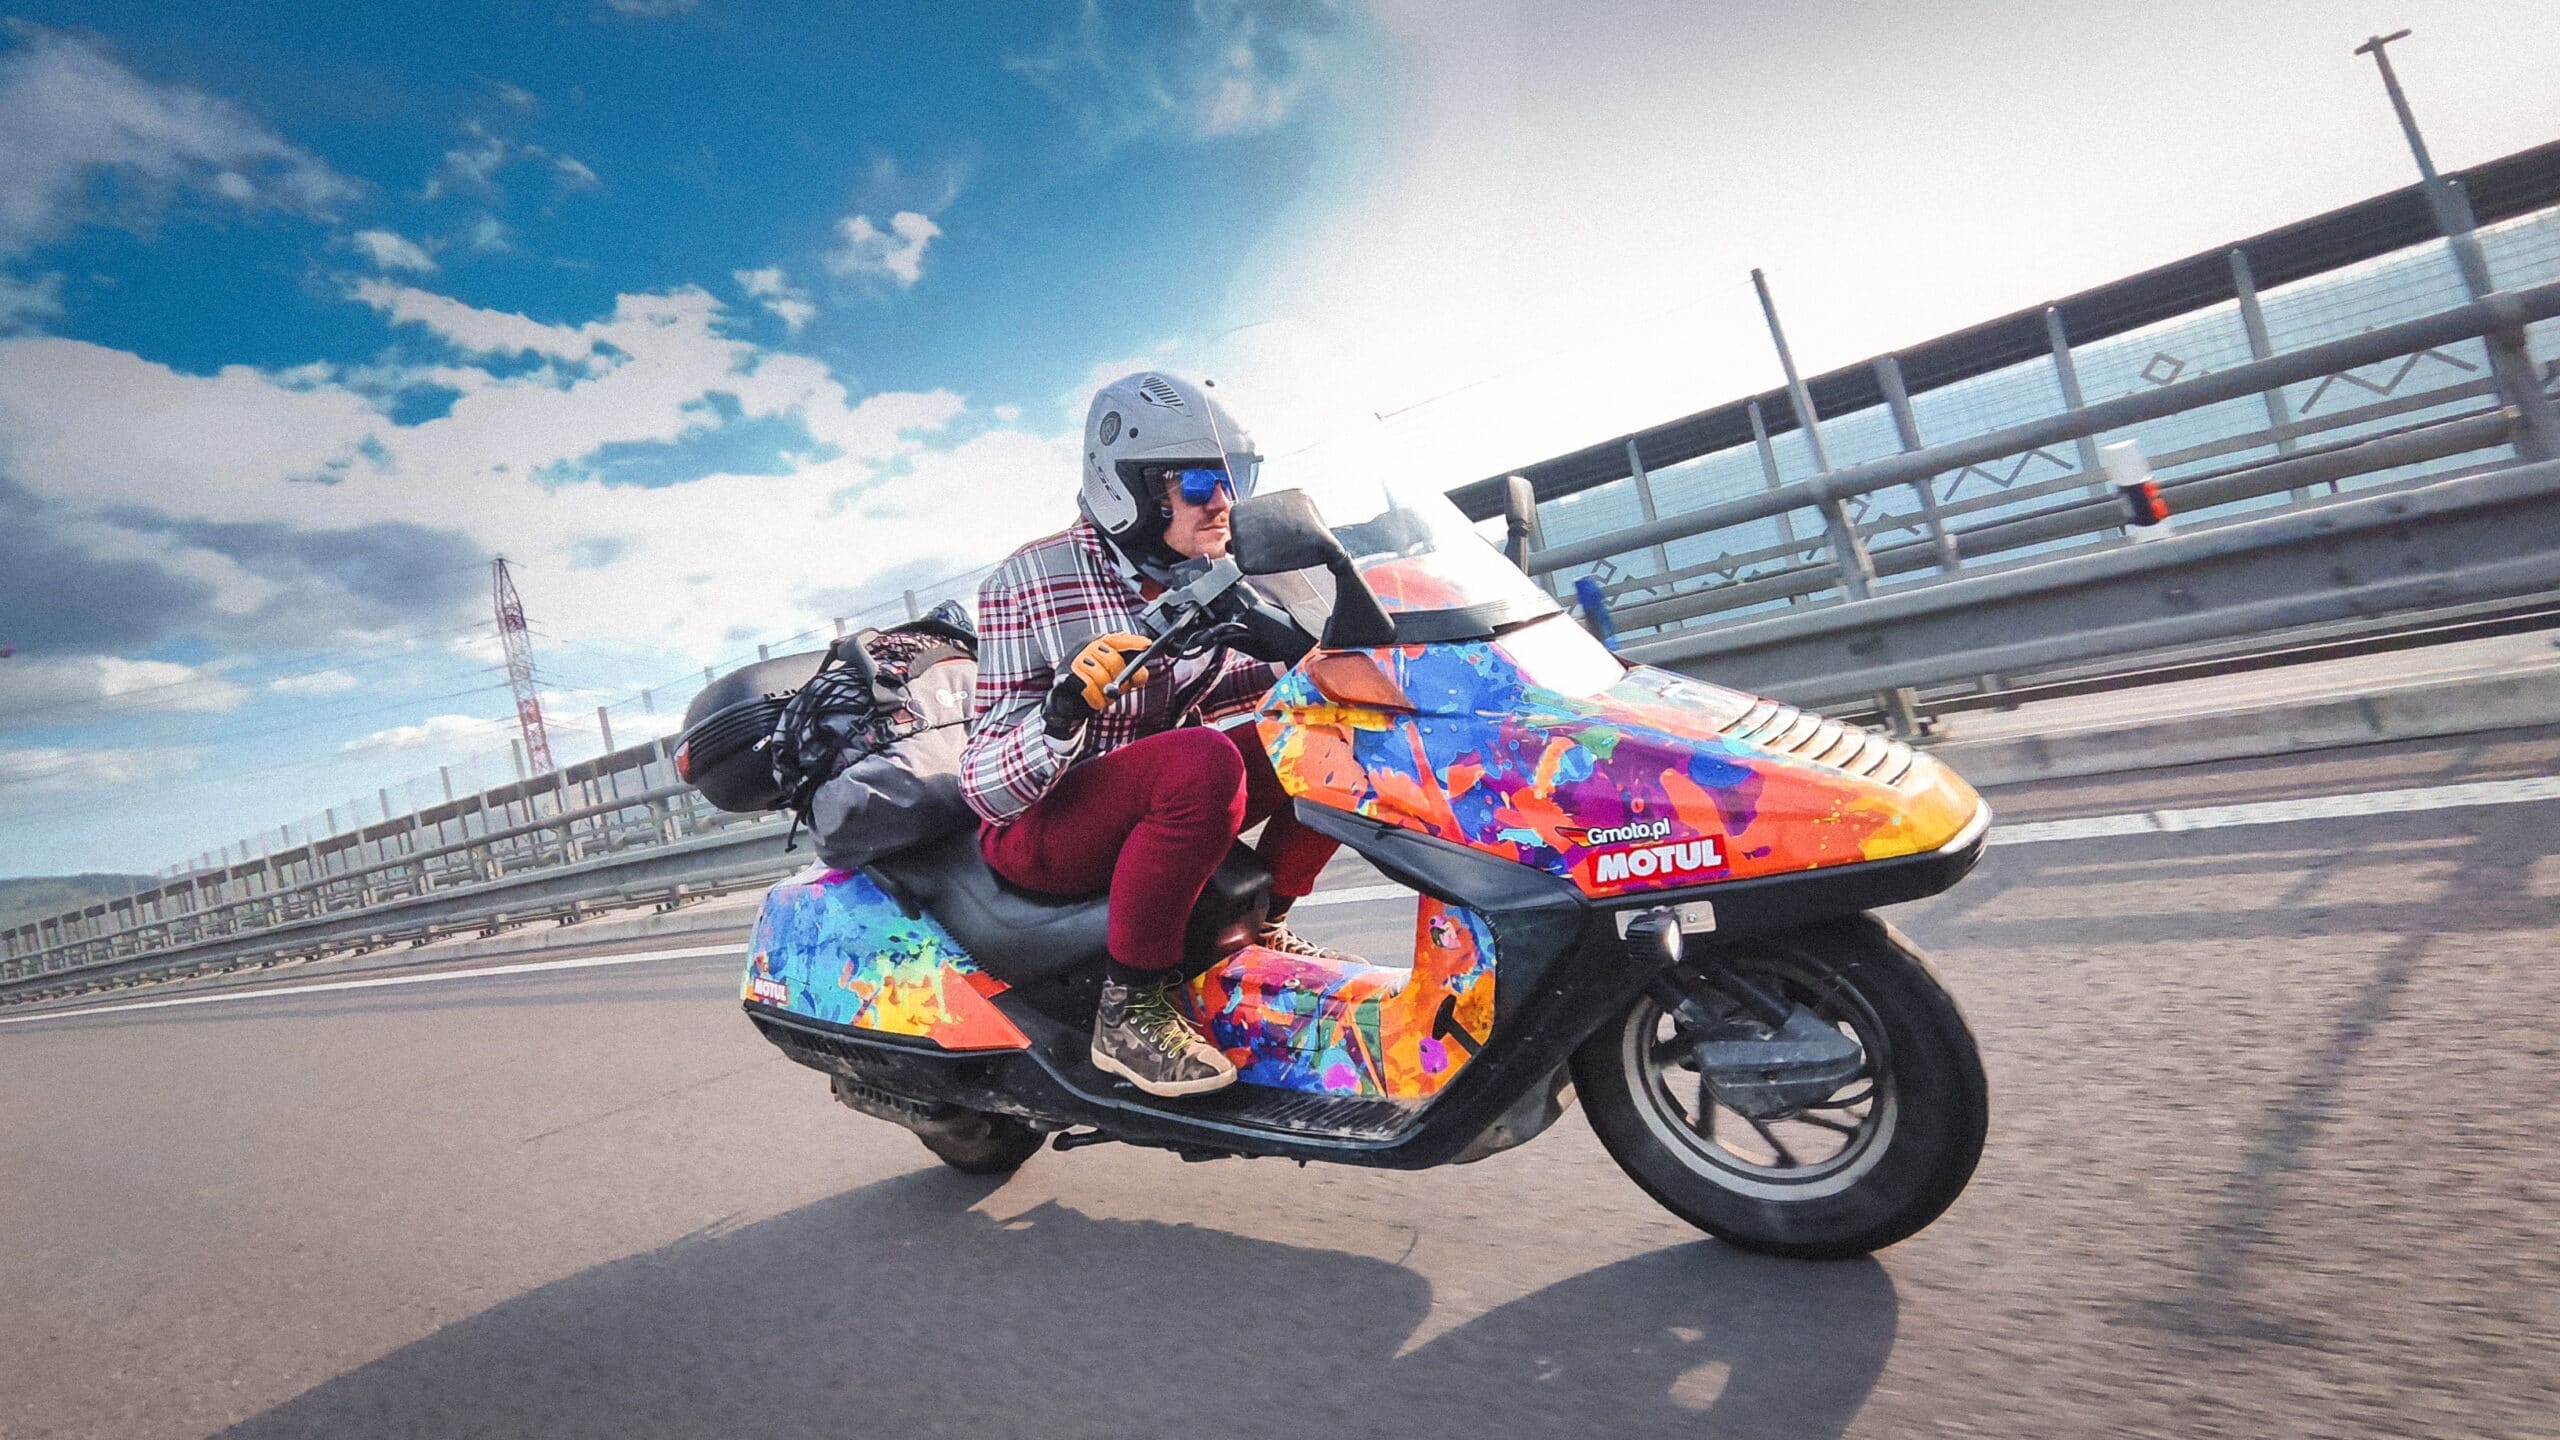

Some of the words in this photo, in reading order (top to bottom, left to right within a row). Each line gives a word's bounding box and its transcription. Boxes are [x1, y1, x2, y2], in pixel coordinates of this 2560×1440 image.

[1587, 818, 1671, 845] Gmoto.pl
[1596, 839, 1722, 883] MOTUL
[755, 978, 787, 1001] MOTUL
